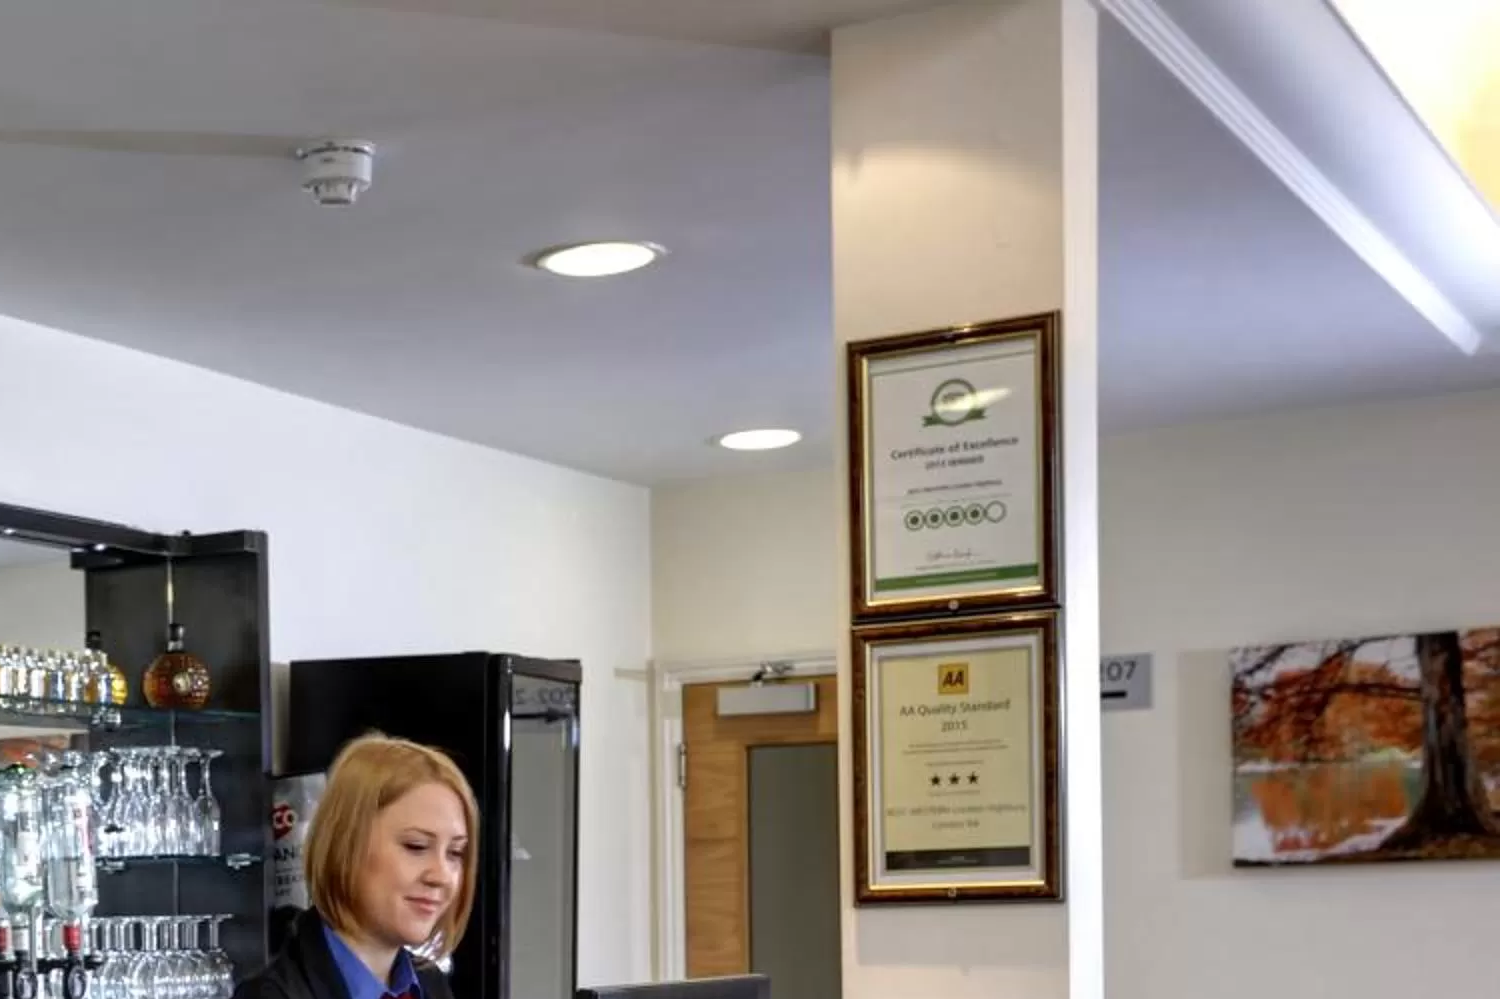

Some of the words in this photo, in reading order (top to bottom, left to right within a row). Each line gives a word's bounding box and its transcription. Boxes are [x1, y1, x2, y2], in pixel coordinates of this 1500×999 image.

[890, 446, 945, 461] Certificate
[948, 441, 961, 453] of
[963, 436, 1019, 450] Excellence
[942, 670, 965, 688] AA
[900, 706, 915, 717] AA
[917, 703, 957, 717] Quality
[960, 698, 1011, 713] Standard
[941, 720, 969, 732] 2015
